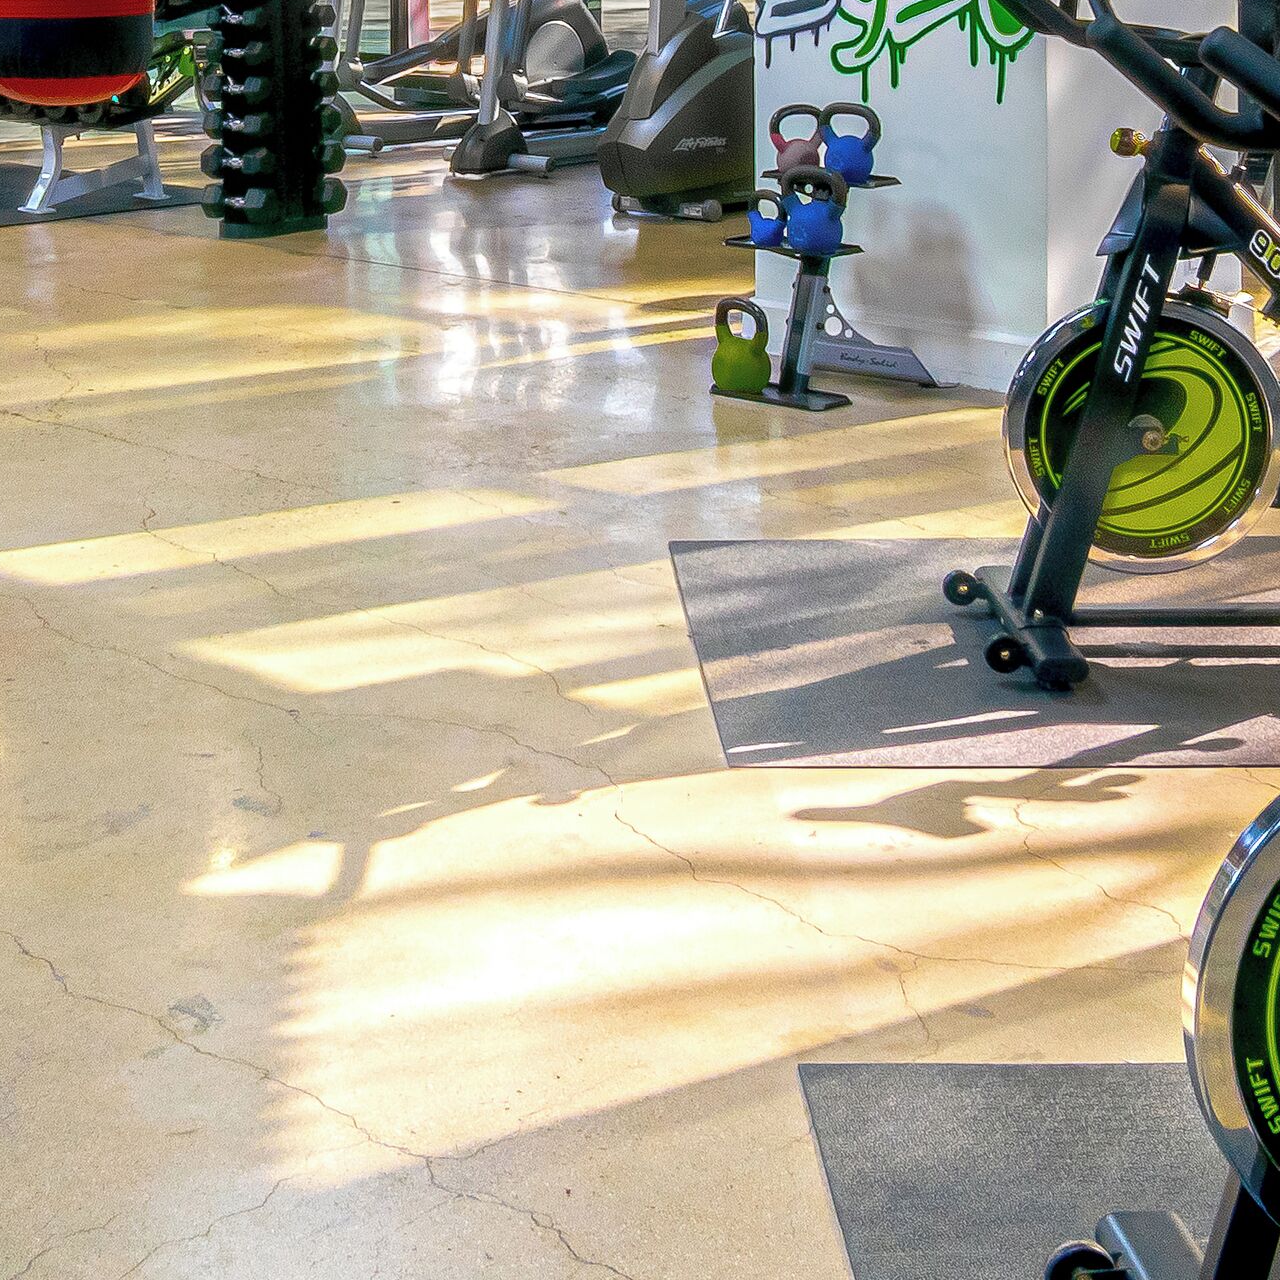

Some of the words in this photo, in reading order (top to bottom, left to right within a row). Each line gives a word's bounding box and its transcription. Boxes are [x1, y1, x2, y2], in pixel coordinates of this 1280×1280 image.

[1114, 254, 1165, 383] SWIFT
[1190, 330, 1226, 358] SWIFT
[1036, 357, 1065, 395] SWIFT
[1245, 391, 1263, 433] SWIFT
[1029, 436, 1045, 478] SWIFT
[1222, 478, 1252, 515] SWIFT
[1149, 532, 1190, 549] SWIFT
